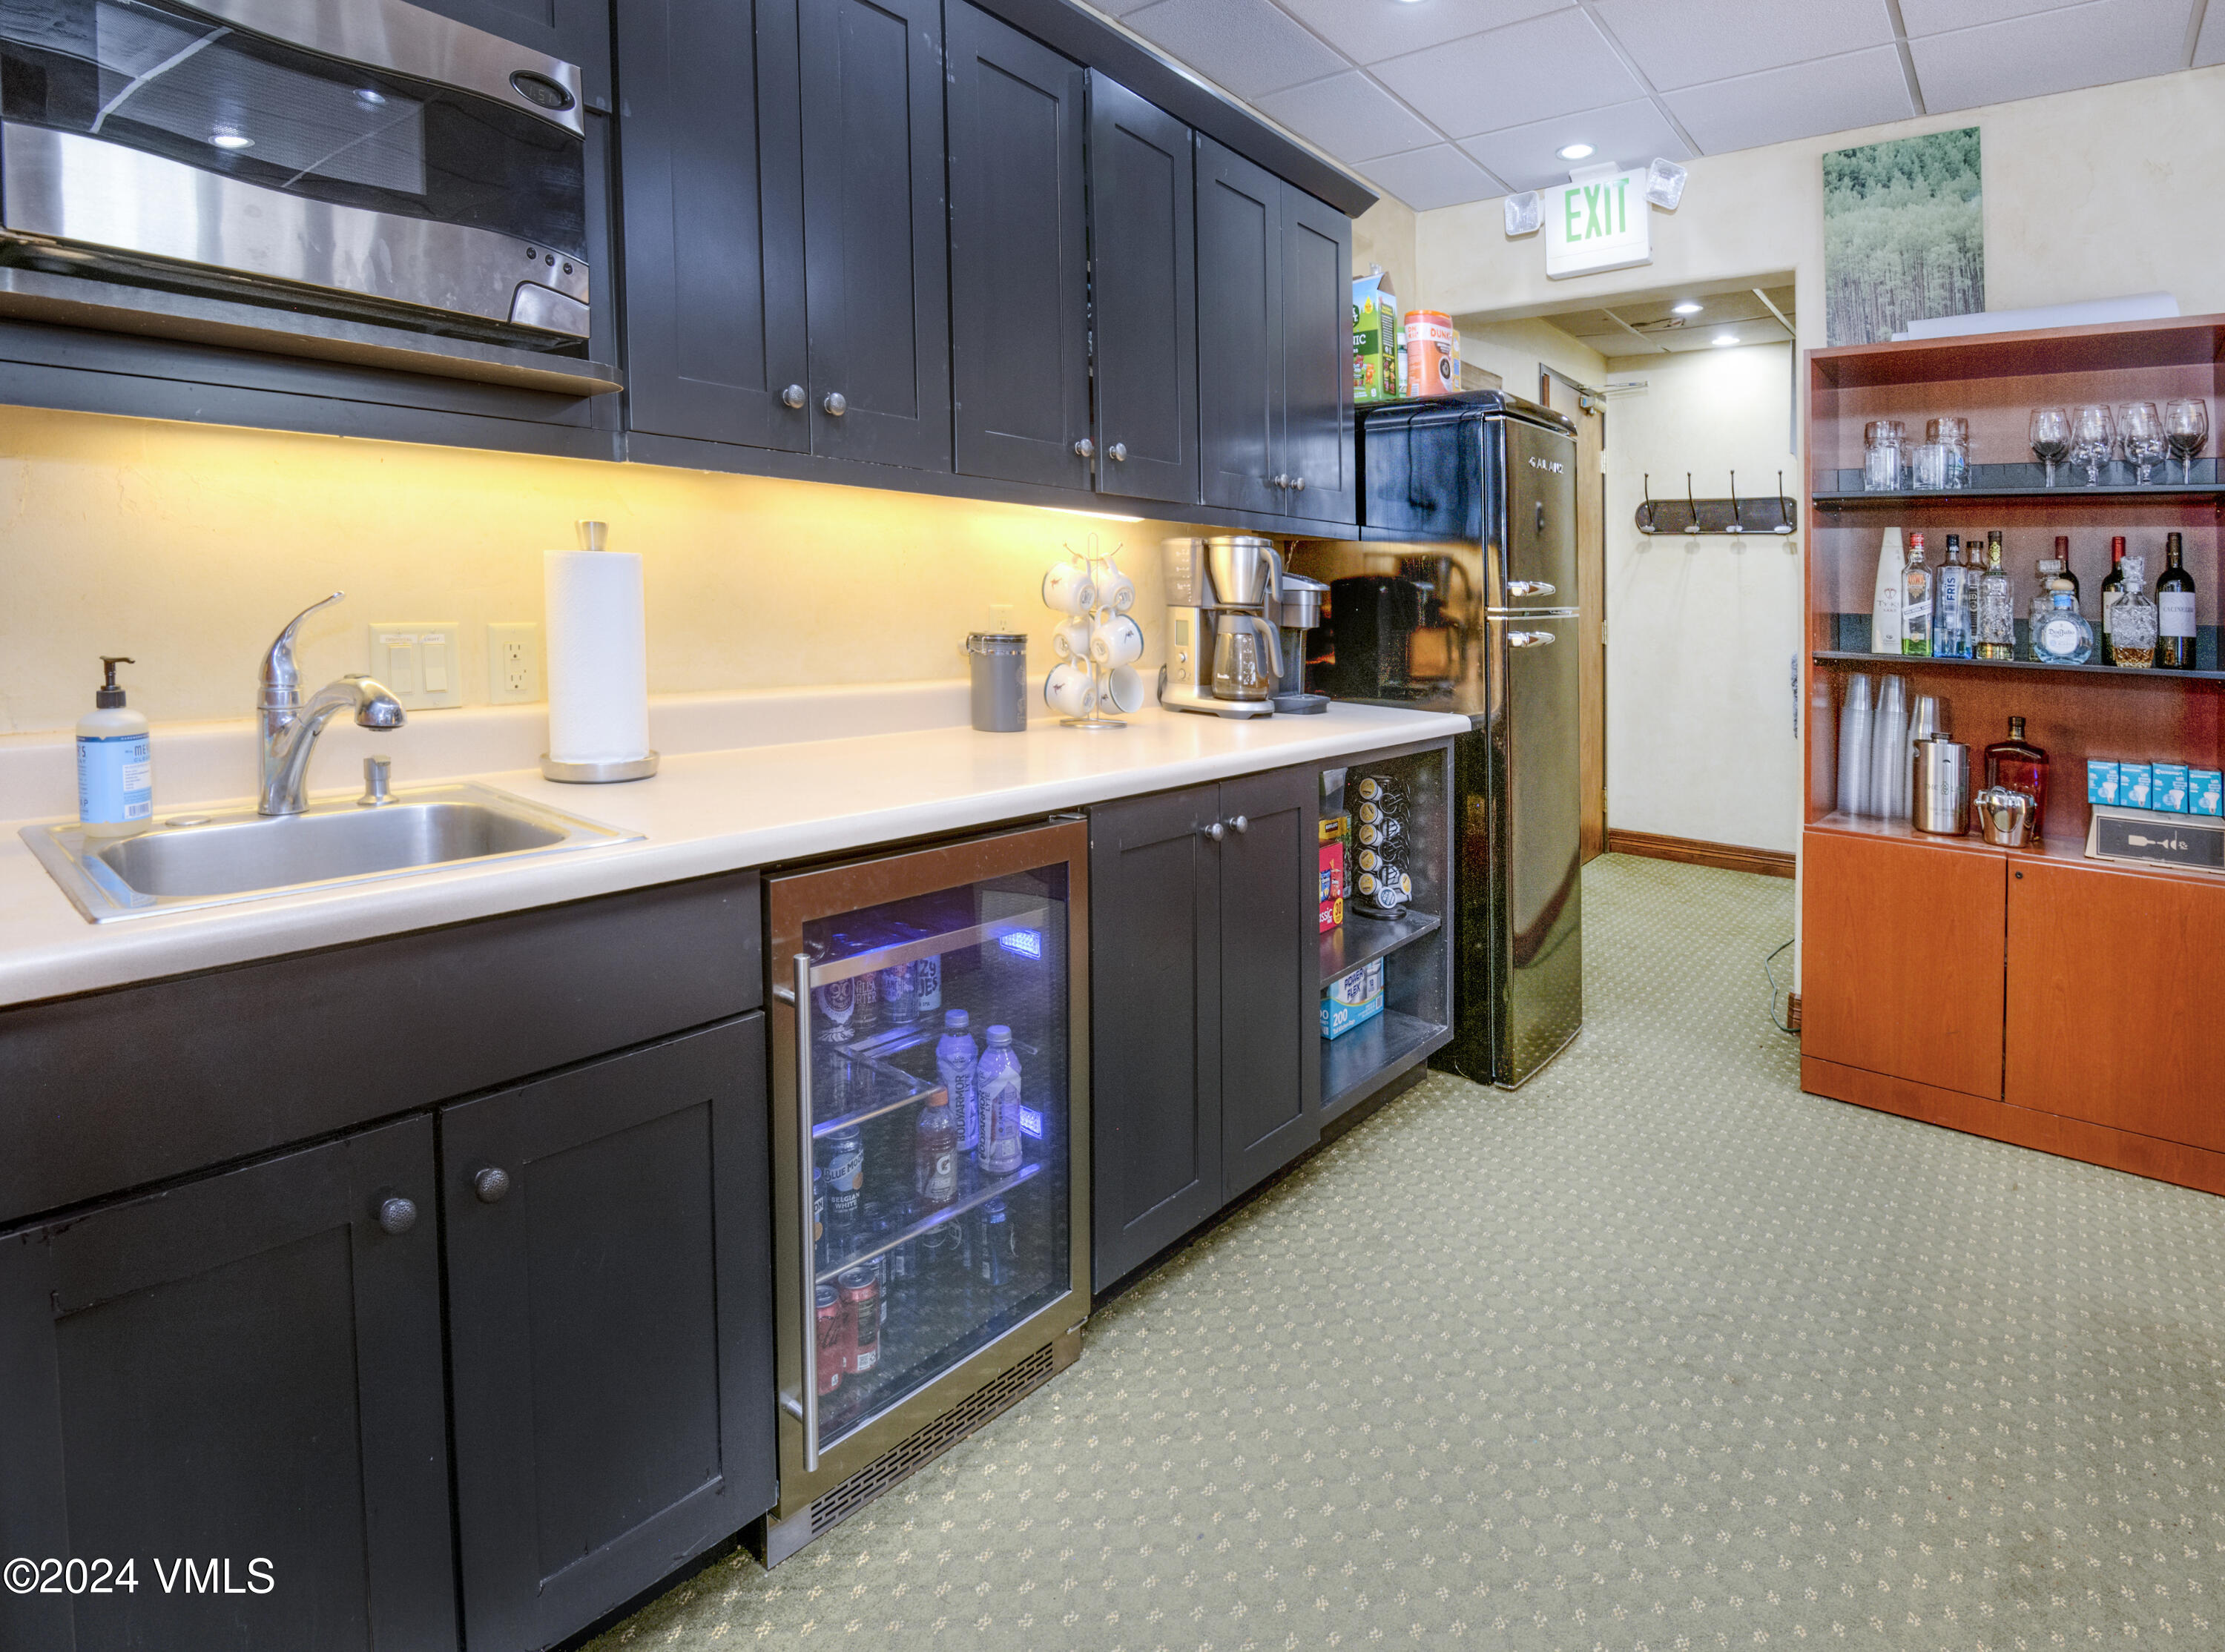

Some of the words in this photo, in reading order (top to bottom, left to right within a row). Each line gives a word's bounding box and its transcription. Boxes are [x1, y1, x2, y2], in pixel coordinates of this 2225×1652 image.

[1565, 177, 1629, 243] EXIT
[1945, 577, 1956, 601] FRÏS
[1335, 902, 1342, 916] 30
[1344, 967, 1364, 991] POWER
[1347, 982, 1361, 1001] FLEX
[1333, 1008, 1348, 1028] 200
[955, 1074, 966, 1142] BODYARMOR
[824, 1167, 846, 1182] BLUE
[936, 1154, 951, 1175] G
[831, 1190, 860, 1203] BELGIAN
[834, 1198, 858, 1210] WHITE
